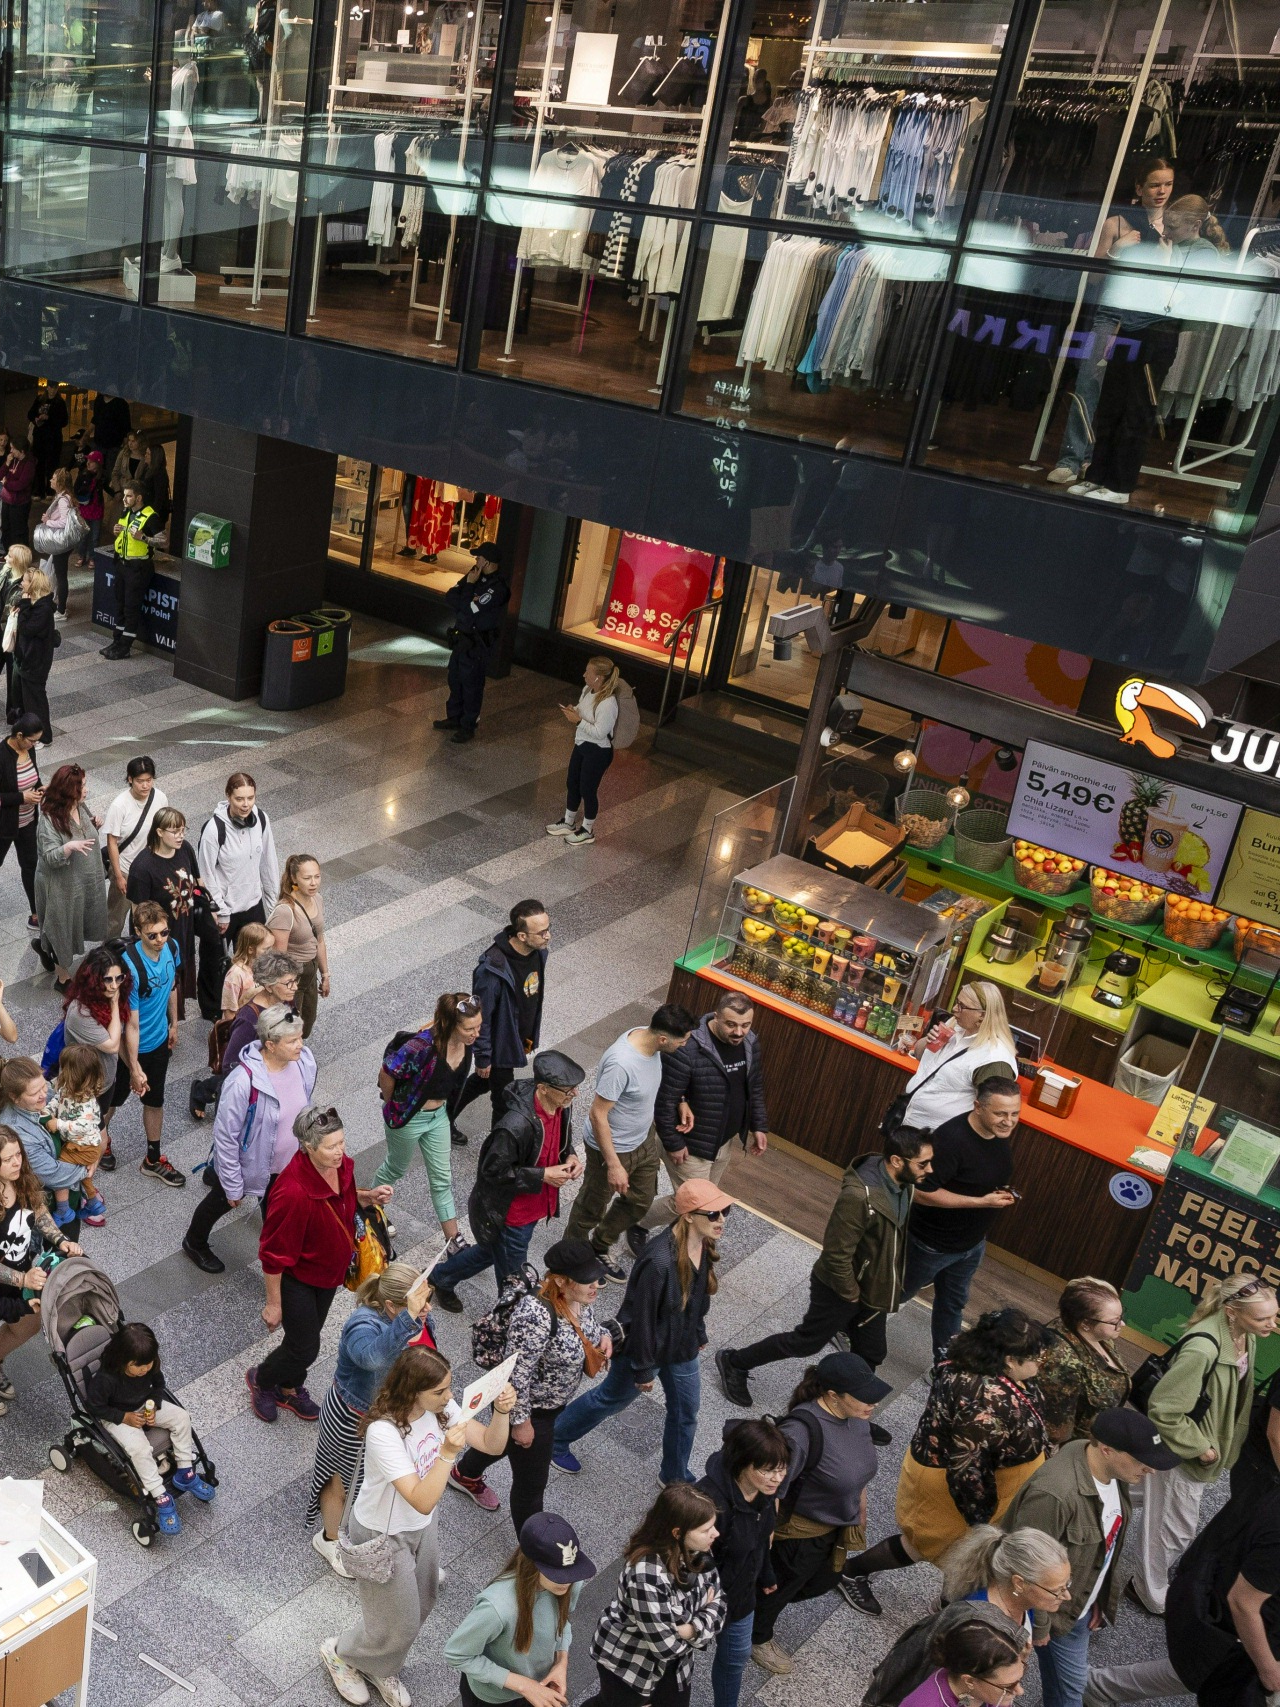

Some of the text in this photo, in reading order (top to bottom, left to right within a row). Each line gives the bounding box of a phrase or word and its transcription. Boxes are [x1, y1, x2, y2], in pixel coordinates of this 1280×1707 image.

[150, 606, 171, 621] Point
[604, 616, 643, 639] Sale
[1210, 728, 1280, 778] JU
[1031, 759, 1117, 792] Päivän smoothie 4dl
[1023, 794, 1044, 807] Chia
[1045, 801, 1074, 817] Lizard
[1026, 769, 1116, 814] 5,49€
[1178, 1104, 1195, 1114] -30
[1178, 1190, 1263, 1249] FEEL
